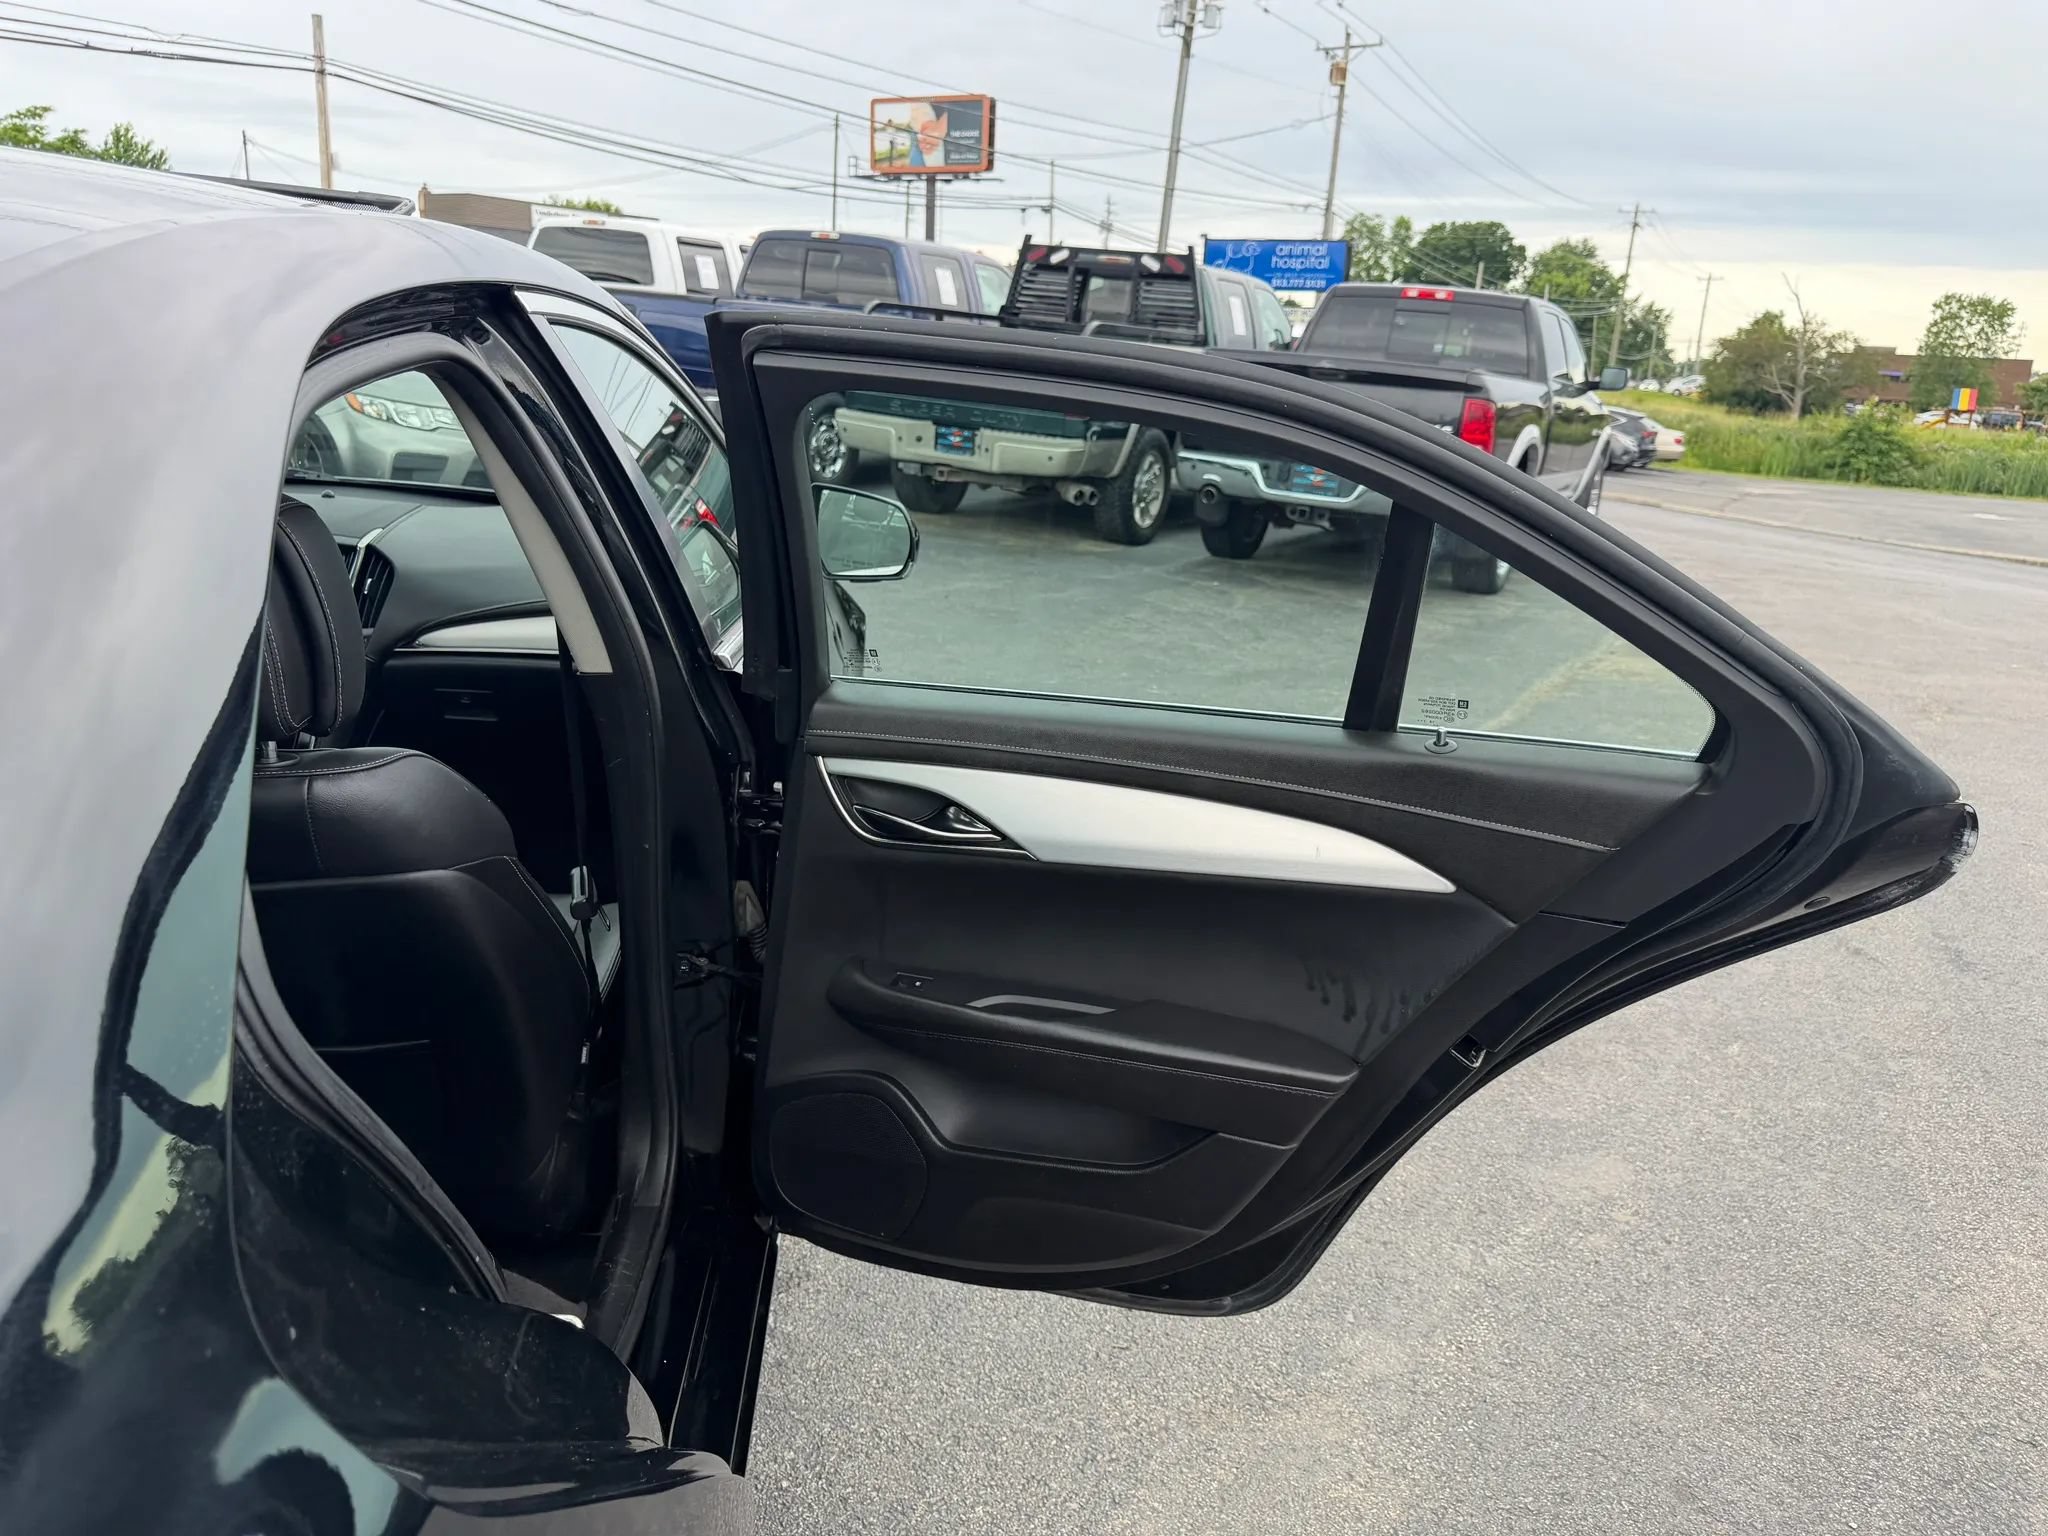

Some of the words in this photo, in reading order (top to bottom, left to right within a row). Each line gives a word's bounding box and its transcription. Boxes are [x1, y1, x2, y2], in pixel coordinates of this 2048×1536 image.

[1275, 243, 1328, 256] animal
[1271, 254, 1331, 271] hospital
[889, 400, 956, 419] SUPER
[969, 410, 1024, 430] DUTY
